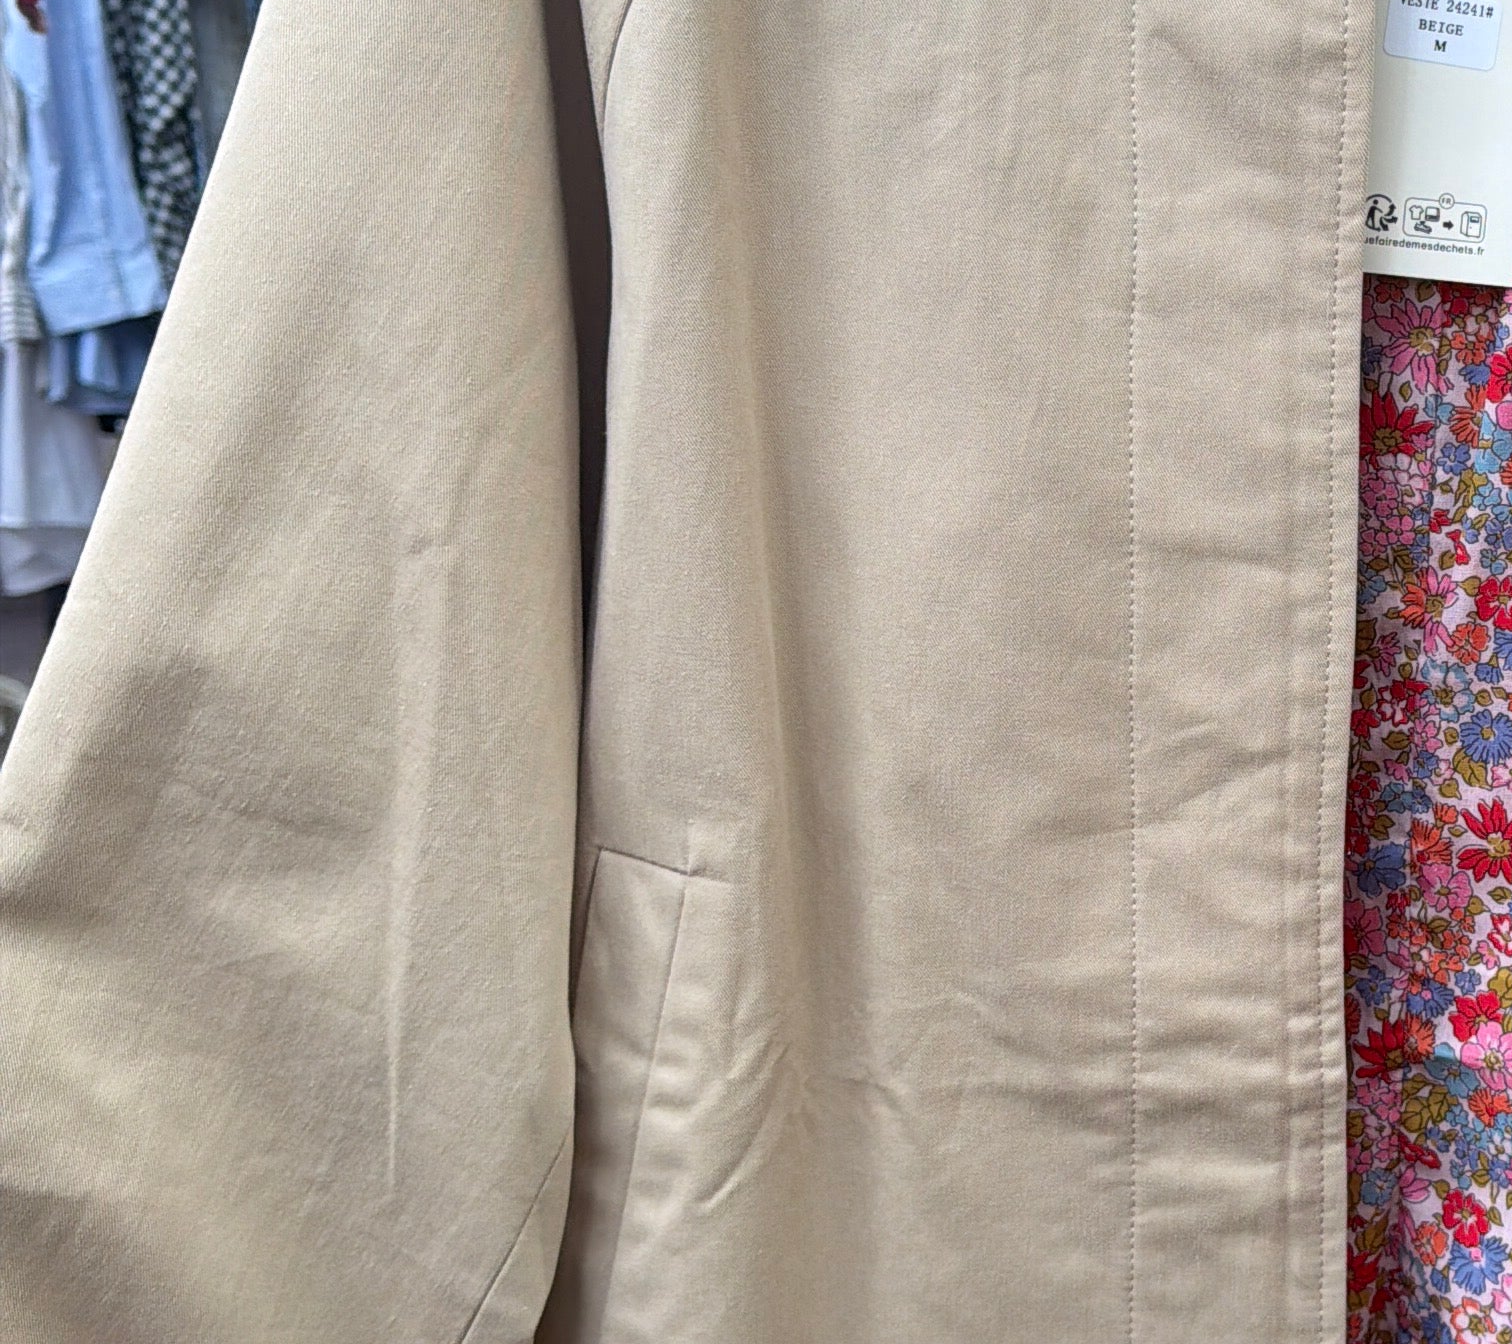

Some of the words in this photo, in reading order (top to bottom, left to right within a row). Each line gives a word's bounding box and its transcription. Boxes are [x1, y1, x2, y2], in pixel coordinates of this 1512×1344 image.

[1446, 0, 1494, 19] 24241#
[1418, 18, 1464, 37] BEIGE
[1433, 39, 1447, 52] M
[1441, 197, 1452, 205] FR
